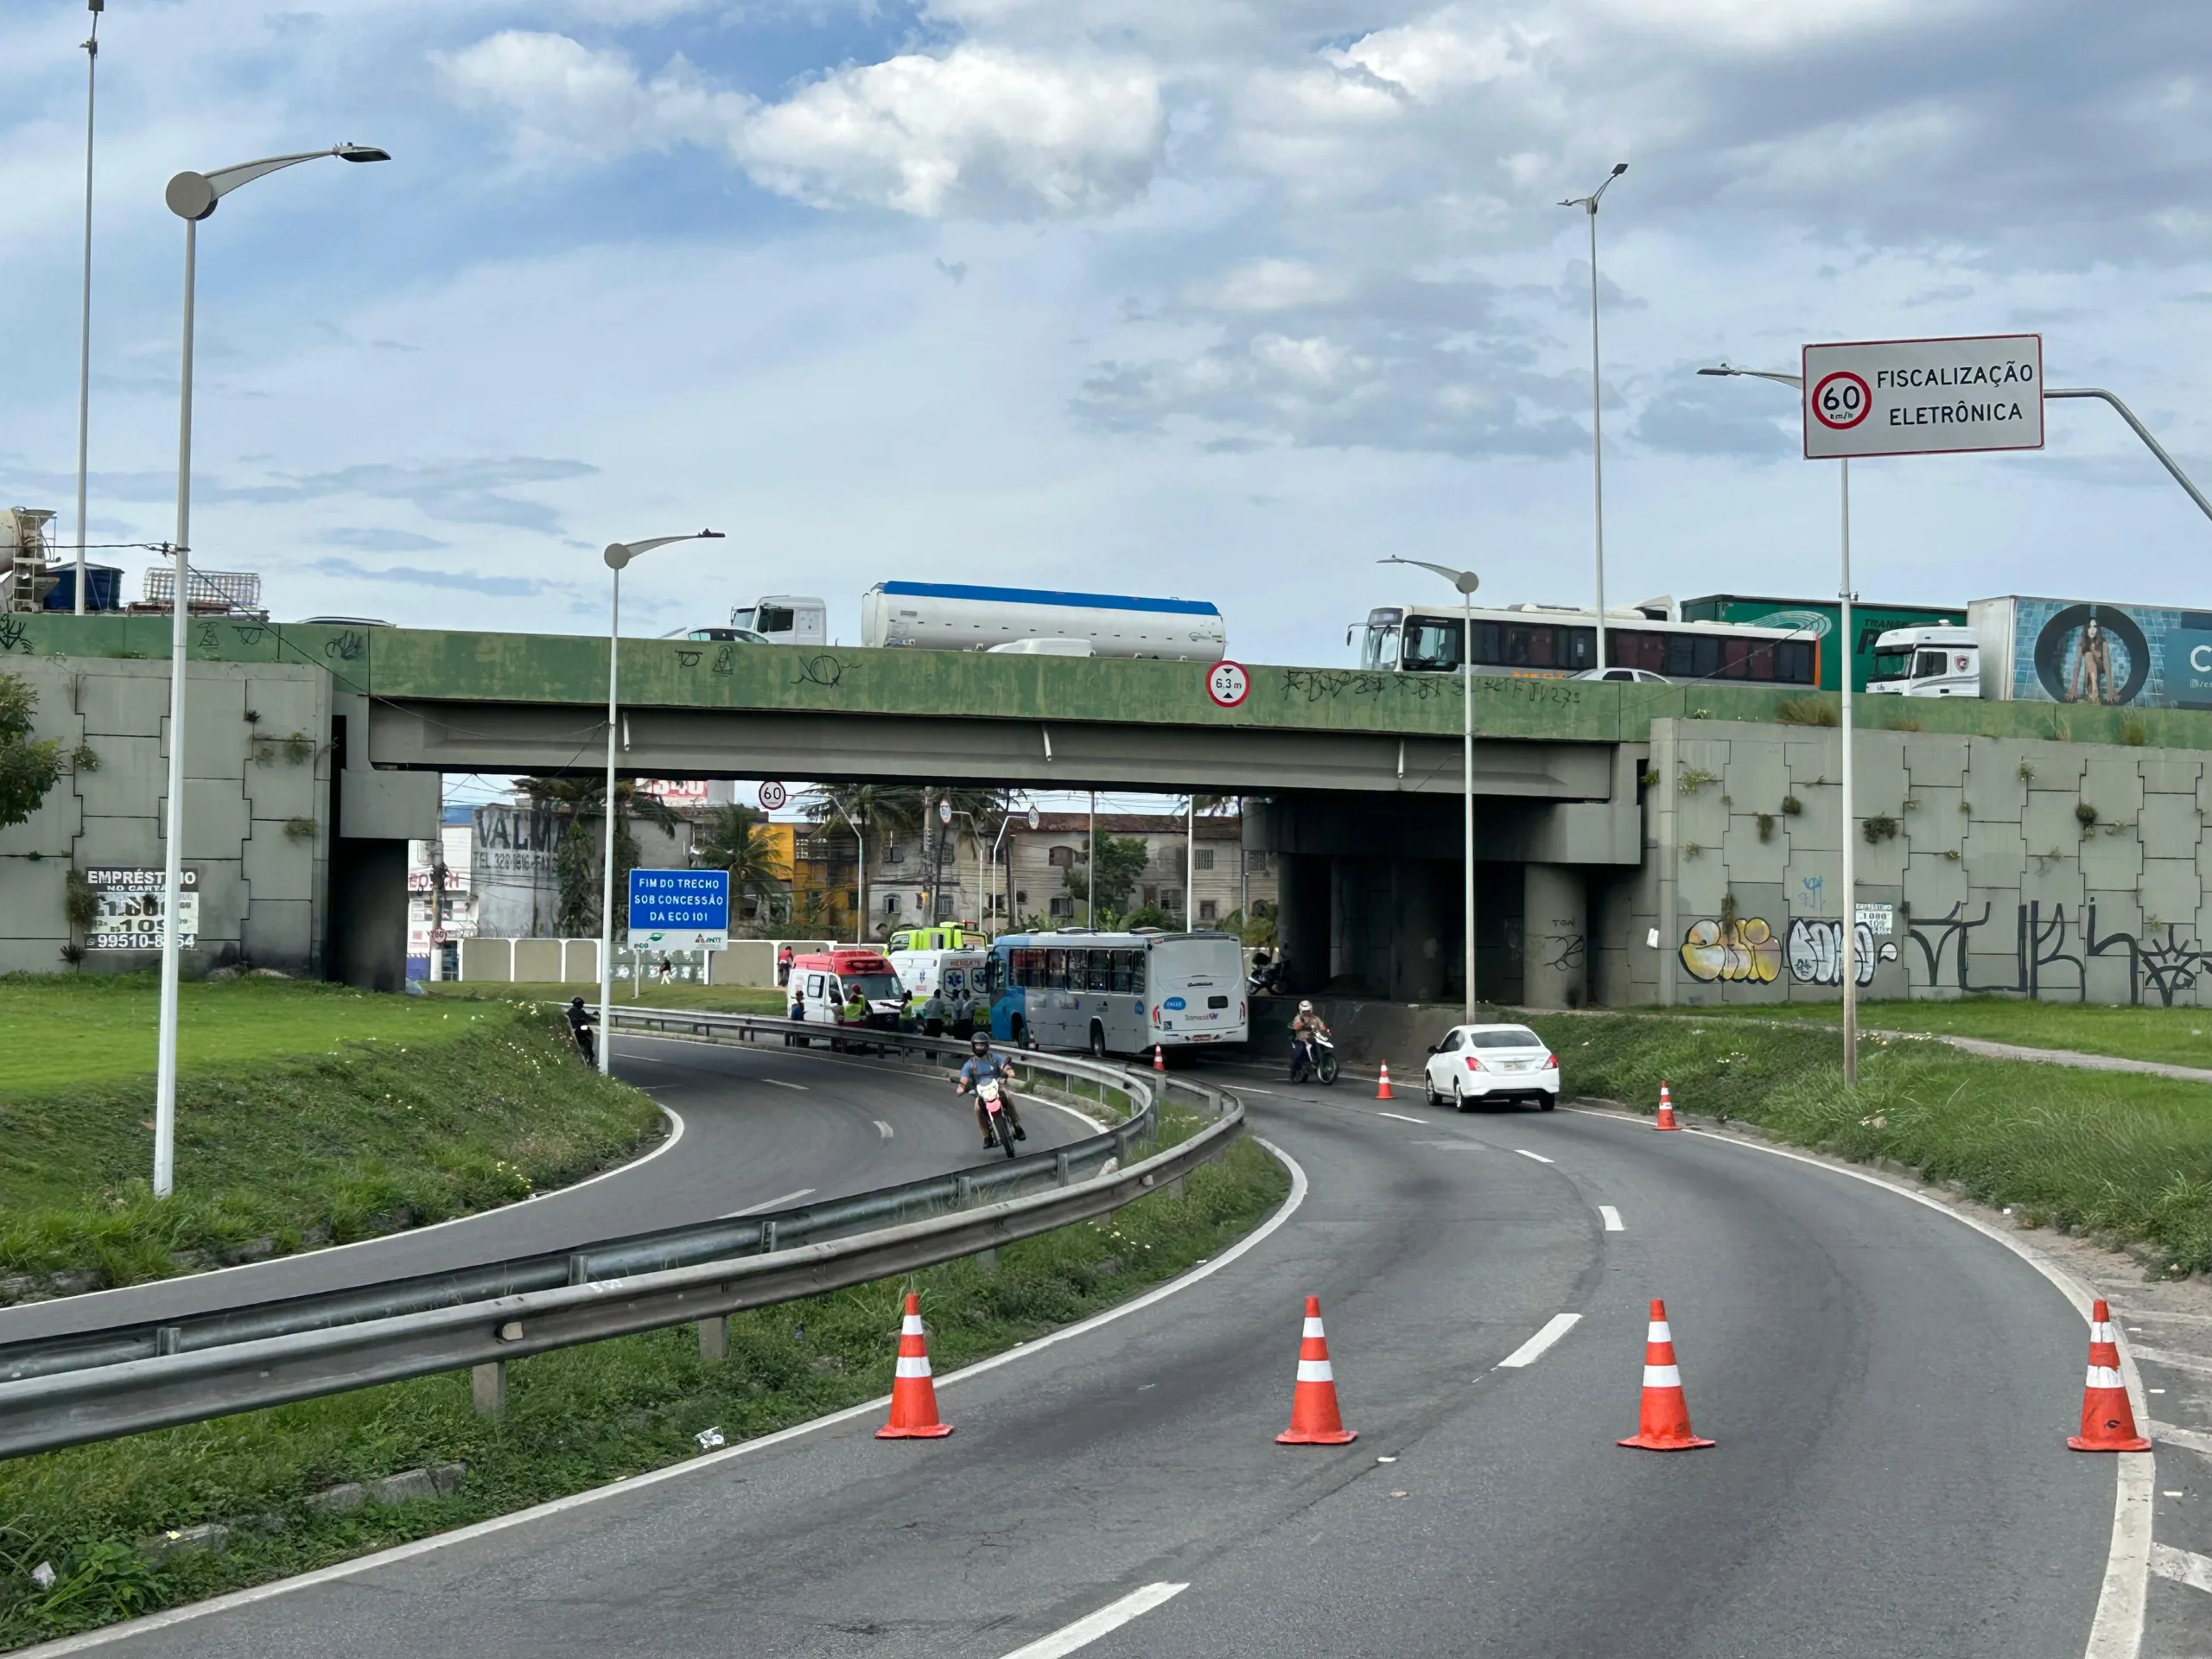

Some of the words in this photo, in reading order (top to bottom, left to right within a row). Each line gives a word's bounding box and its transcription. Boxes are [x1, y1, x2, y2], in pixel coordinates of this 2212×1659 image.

[1877, 360, 2033, 388] FISCALIZAÇÃO
[1823, 385, 1860, 411] 60
[1890, 400, 2023, 426] ELETRÔNICA
[763, 787, 782, 800] 60
[87, 868, 197, 885] EMPRÉSTO
[639, 879, 657, 888] FIM
[660, 880, 674, 888] DO
[677, 879, 719, 889] TRECHO
[634, 895, 655, 905] SOB
[658, 893, 723, 906] CONCESSÃO
[650, 912, 664, 921] DA
[668, 912, 690, 922] ECO
[97, 934, 195, 948] 99510-864
